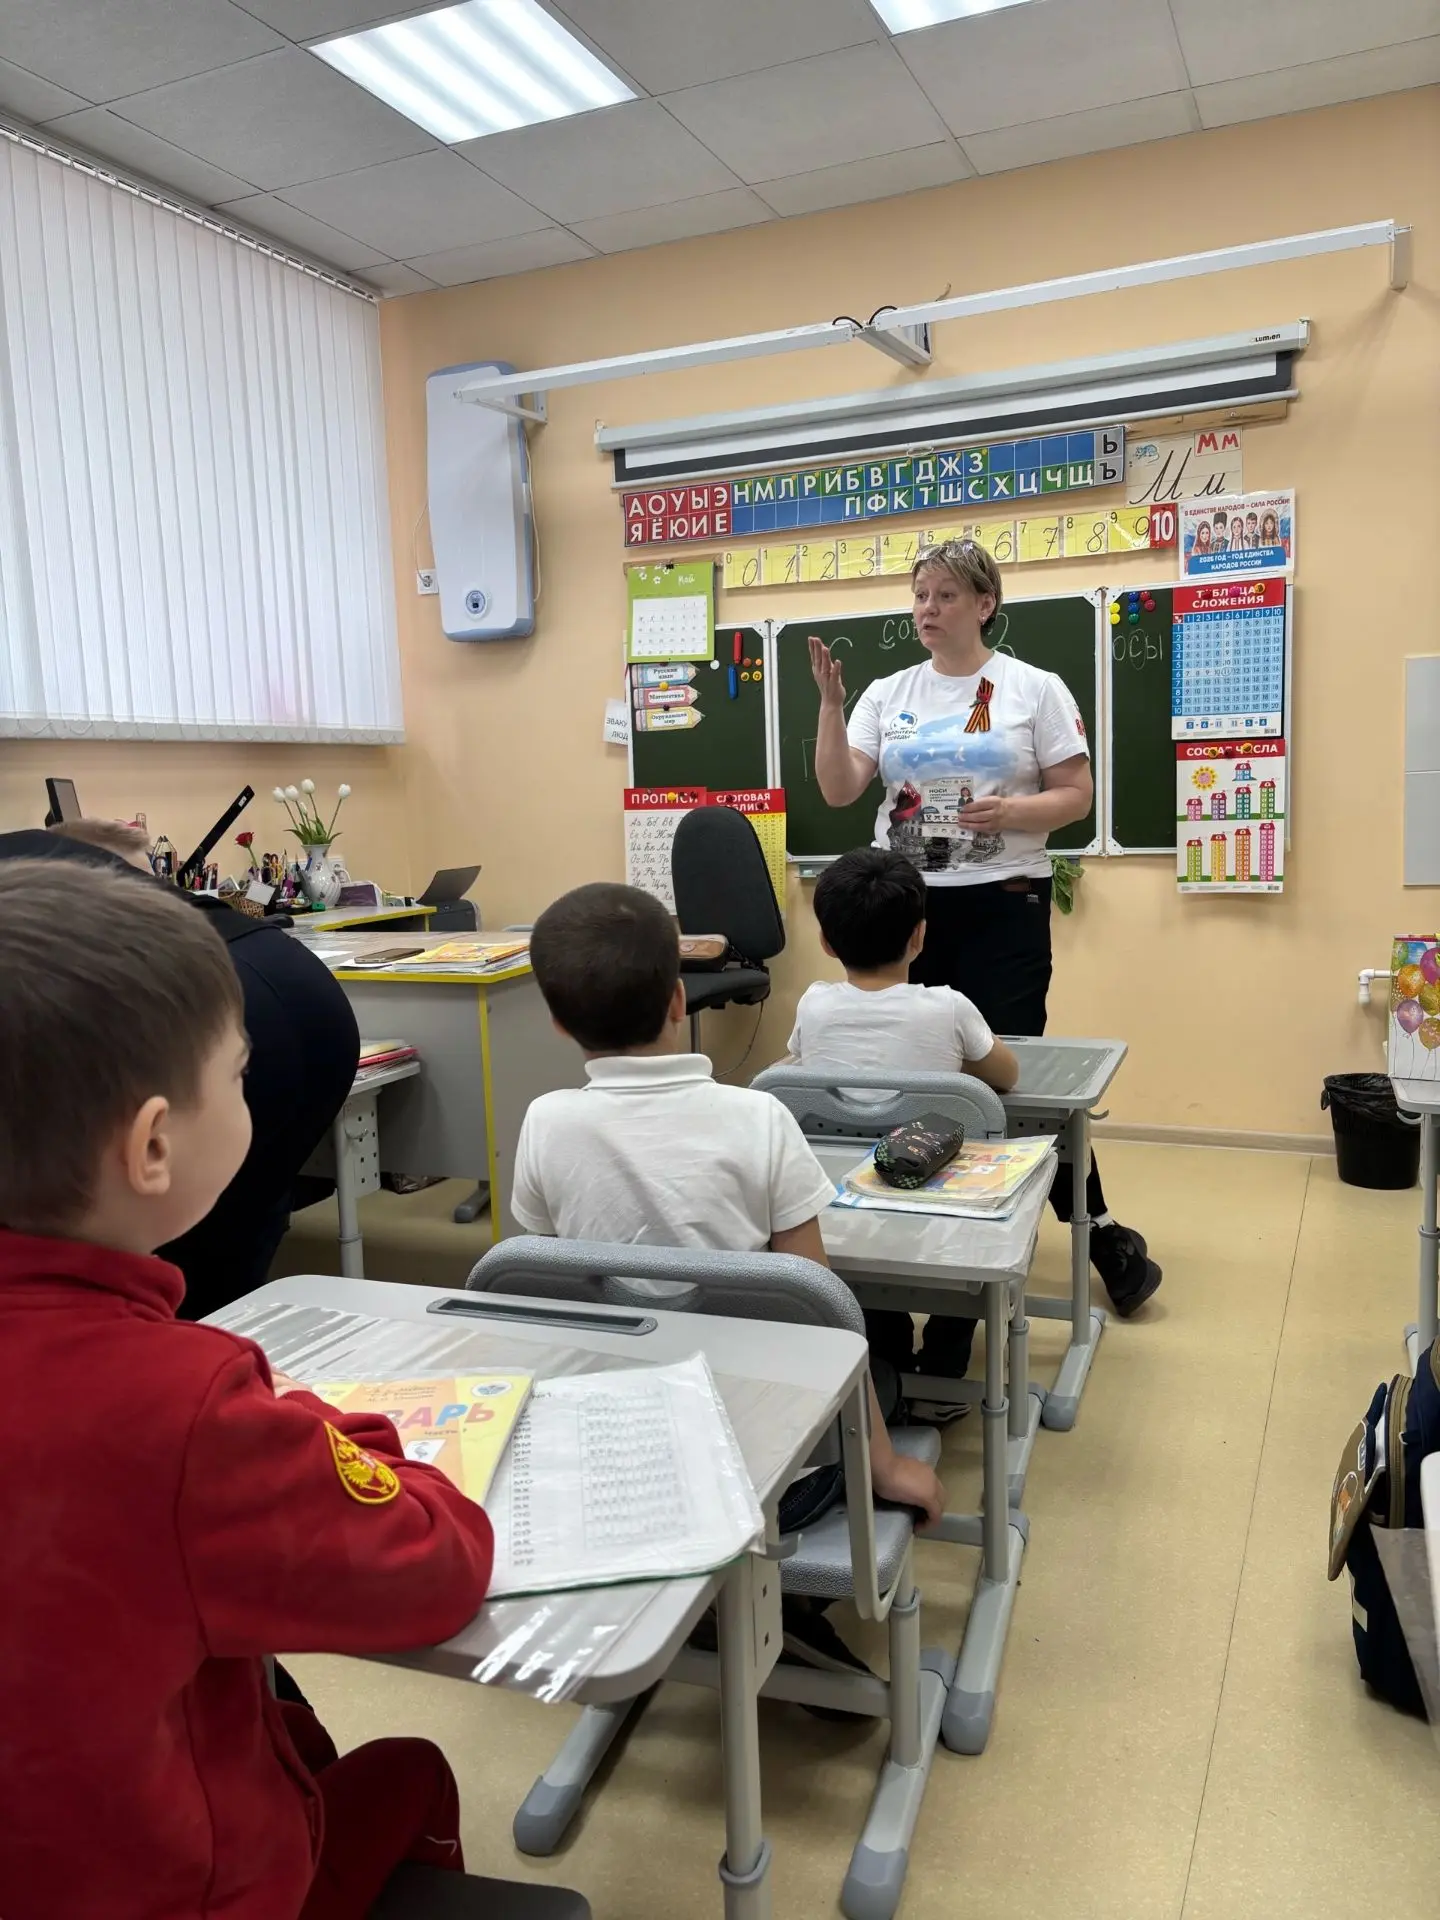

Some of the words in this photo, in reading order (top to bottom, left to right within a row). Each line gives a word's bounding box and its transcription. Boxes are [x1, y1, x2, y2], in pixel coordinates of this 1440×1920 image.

[1218, 504, 1245, 512] НАРОДОВ
[726, 554, 732, 564] 0
[742, 558, 758, 586] 0
[764, 550, 768, 560] 1
[785, 555, 796, 583] 1
[802, 547, 808, 557] 2
[820, 552, 836, 579] 2
[840, 543, 847, 554] 3
[859, 548, 875, 576] 3
[884, 537, 890, 548] 4
[927, 531, 934, 542] 5
[975, 526, 981, 537] 6
[994, 531, 1012, 560] 6
[1020, 522, 1027, 533] 7
[1043, 526, 1058, 557] 7
[1066, 517, 1073, 529] 8
[1087, 522, 1106, 552] 8
[1110, 511, 1118, 524] 9
[1151, 510, 1174, 541] 10
[1244, 550, 1274, 558] ЕДИНСТВА
[1211, 562, 1239, 570] НАРОДОВ
[1196, 586, 1256, 598] ТБЛЦА
[1192, 595, 1264, 608] СЛОЖЕНИЯ
[1236, 744, 1278, 754] ЧСЛА
